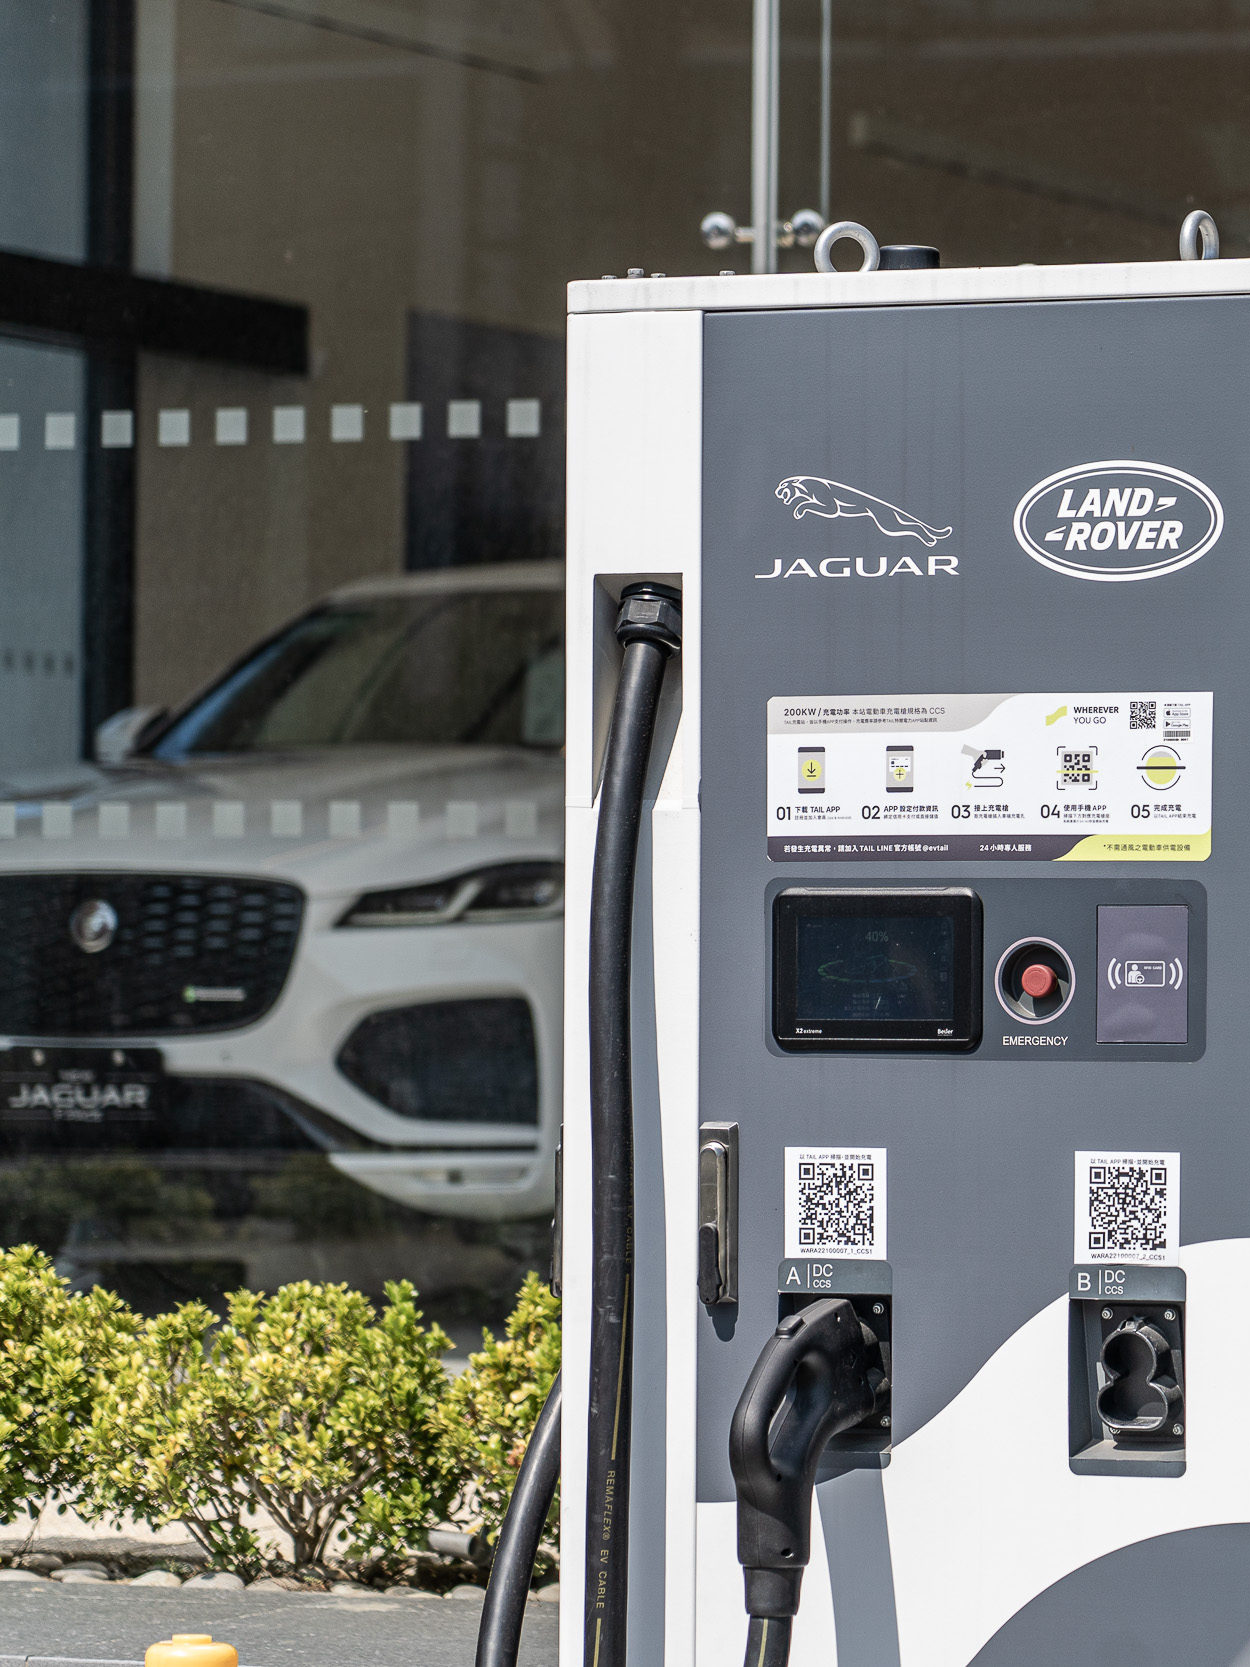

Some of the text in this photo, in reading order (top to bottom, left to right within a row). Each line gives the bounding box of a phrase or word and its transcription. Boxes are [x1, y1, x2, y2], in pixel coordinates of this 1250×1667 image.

[1057, 487, 1155, 518] LAND
[1064, 520, 1184, 551] ROVER
[755, 555, 960, 579] JAGUAR
[784, 708, 816, 717] 200KW
[823, 708, 849, 716] 充電功率
[929, 707, 945, 715] CCS
[1073, 706, 1119, 714] WHEREVER
[776, 806, 791, 820] 01
[861, 805, 881, 820] 02
[951, 804, 971, 819] 03
[974, 804, 1009, 812] 接上充電槍
[1040, 804, 1061, 819] 04
[1130, 804, 1151, 819] 05
[1153, 804, 1182, 812] 完成充電
[922, 844, 949, 852] @evtail
[865, 931, 889, 942] 40%
[1002, 1036, 1069, 1046] EMERGENCY
[8, 1083, 150, 1109] JAGUAR
[786, 1266, 801, 1285] A
[813, 1264, 833, 1277] DC
[1105, 1270, 1125, 1283] DC
[813, 1280, 832, 1288] CCS
[1078, 1273, 1091, 1291] B
[1105, 1286, 1124, 1294] CCS
[600, 1549, 609, 1564] EV
[596, 1571, 608, 1609] CABLE
